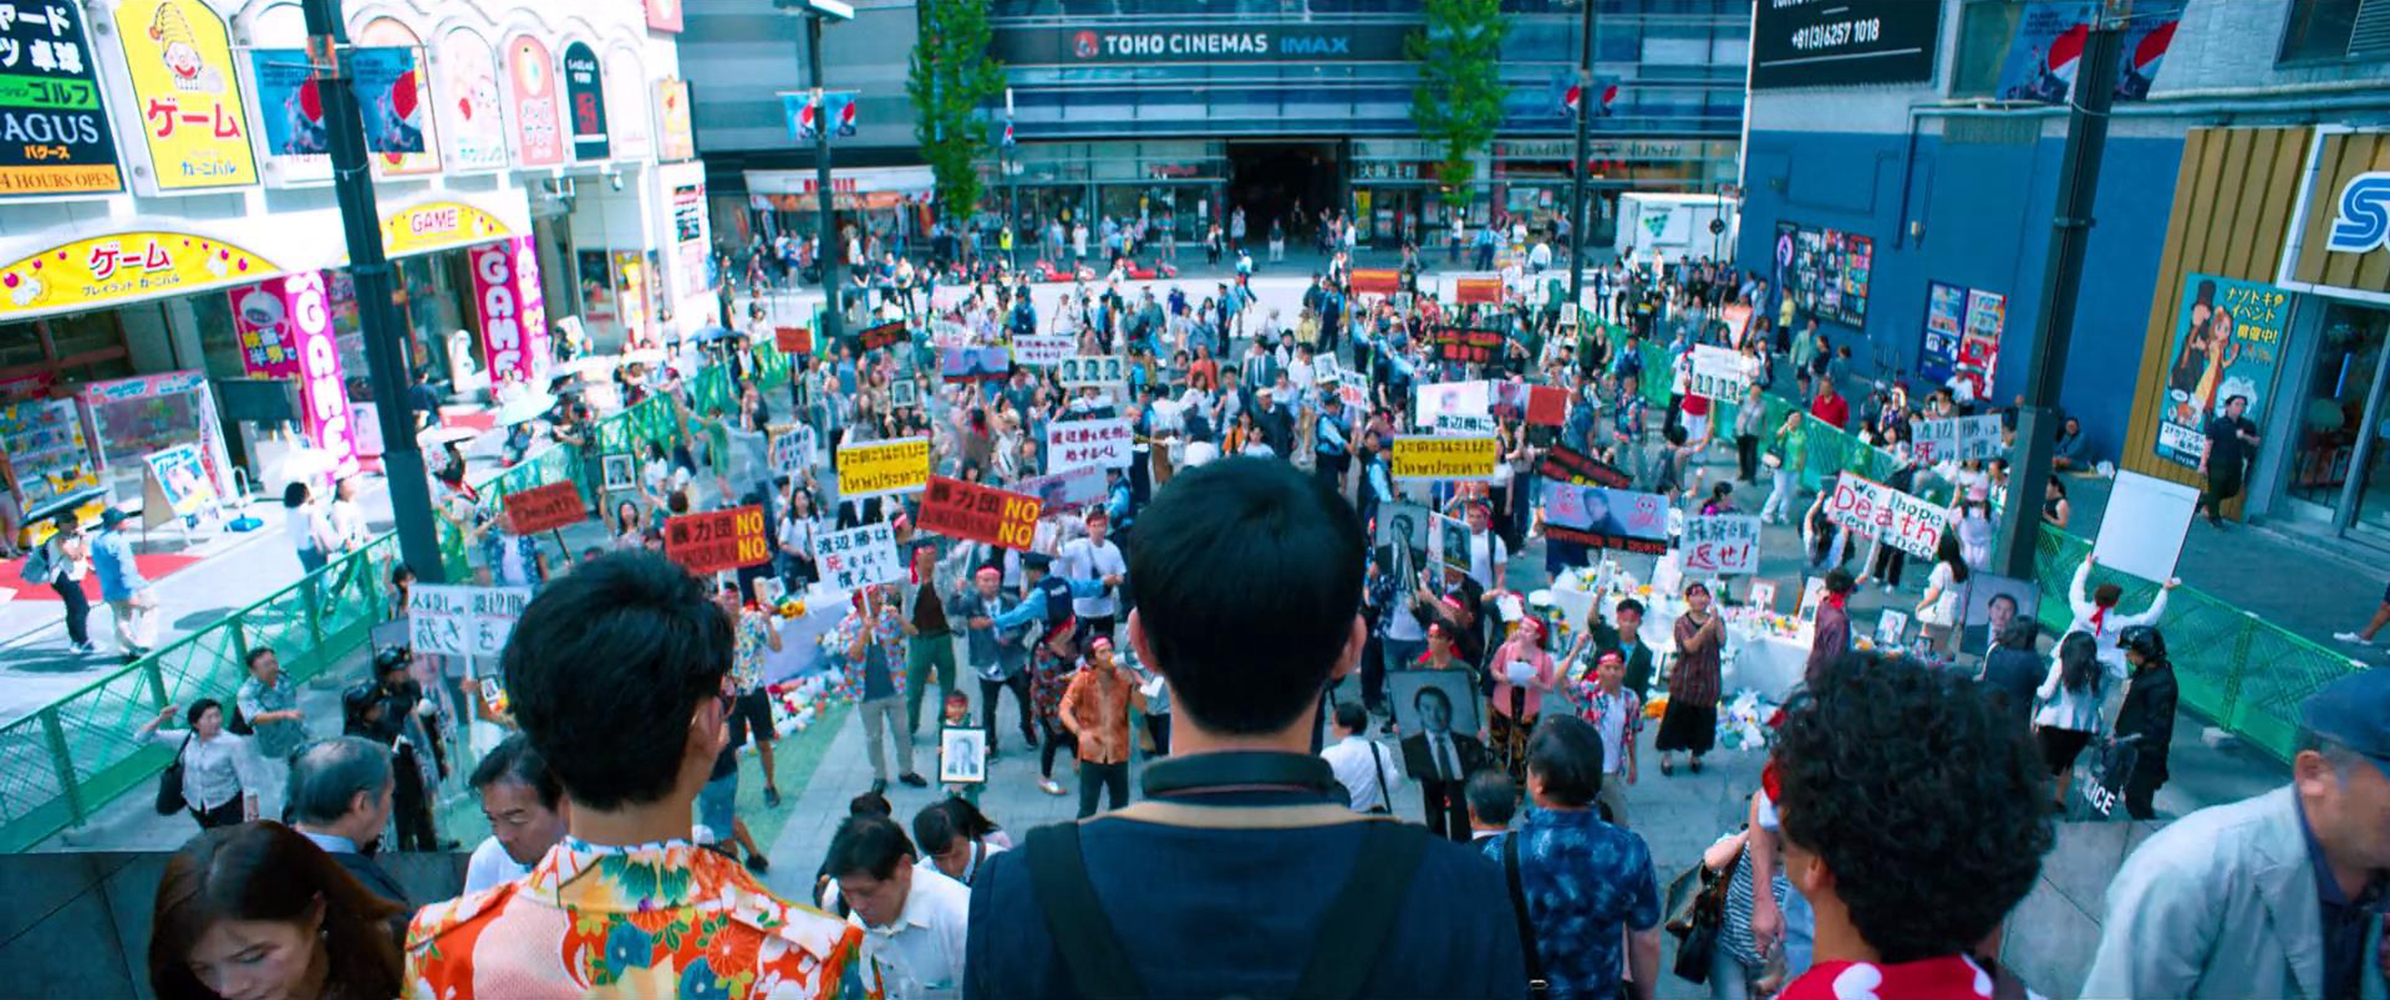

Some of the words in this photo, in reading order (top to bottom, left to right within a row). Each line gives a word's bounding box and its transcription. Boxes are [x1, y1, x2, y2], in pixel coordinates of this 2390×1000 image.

[1105, 35, 1164, 54] TOHO
[1169, 33, 1268, 53] CINEMAS
[1280, 36, 1349, 53] IMAX
[1792, 21, 1851, 49] +81(3)6257
[1853, 17, 1880, 42] 1018
[28, 81, 90, 104] ゴルフ
[0, 112, 99, 144] AGUS
[148, 97, 241, 138] ゲーム
[14, 172, 72, 188] HOURS
[76, 171, 115, 188] OPEN
[412, 209, 456, 232] GAME
[2327, 172, 2390, 252] S
[90, 243, 171, 278] ゲーム
[479, 251, 522, 380] GAME
[2232, 301, 2275, 323] イベント
[295, 289, 349, 451] GAME
[737, 511, 764, 536] NO
[1005, 496, 1039, 523] NO
[1834, 485, 1937, 546] Death
[1898, 495, 1942, 526] hope
[998, 521, 1033, 547] NO
[738, 536, 766, 562] NO
[1686, 542, 1750, 571] 返せ!
